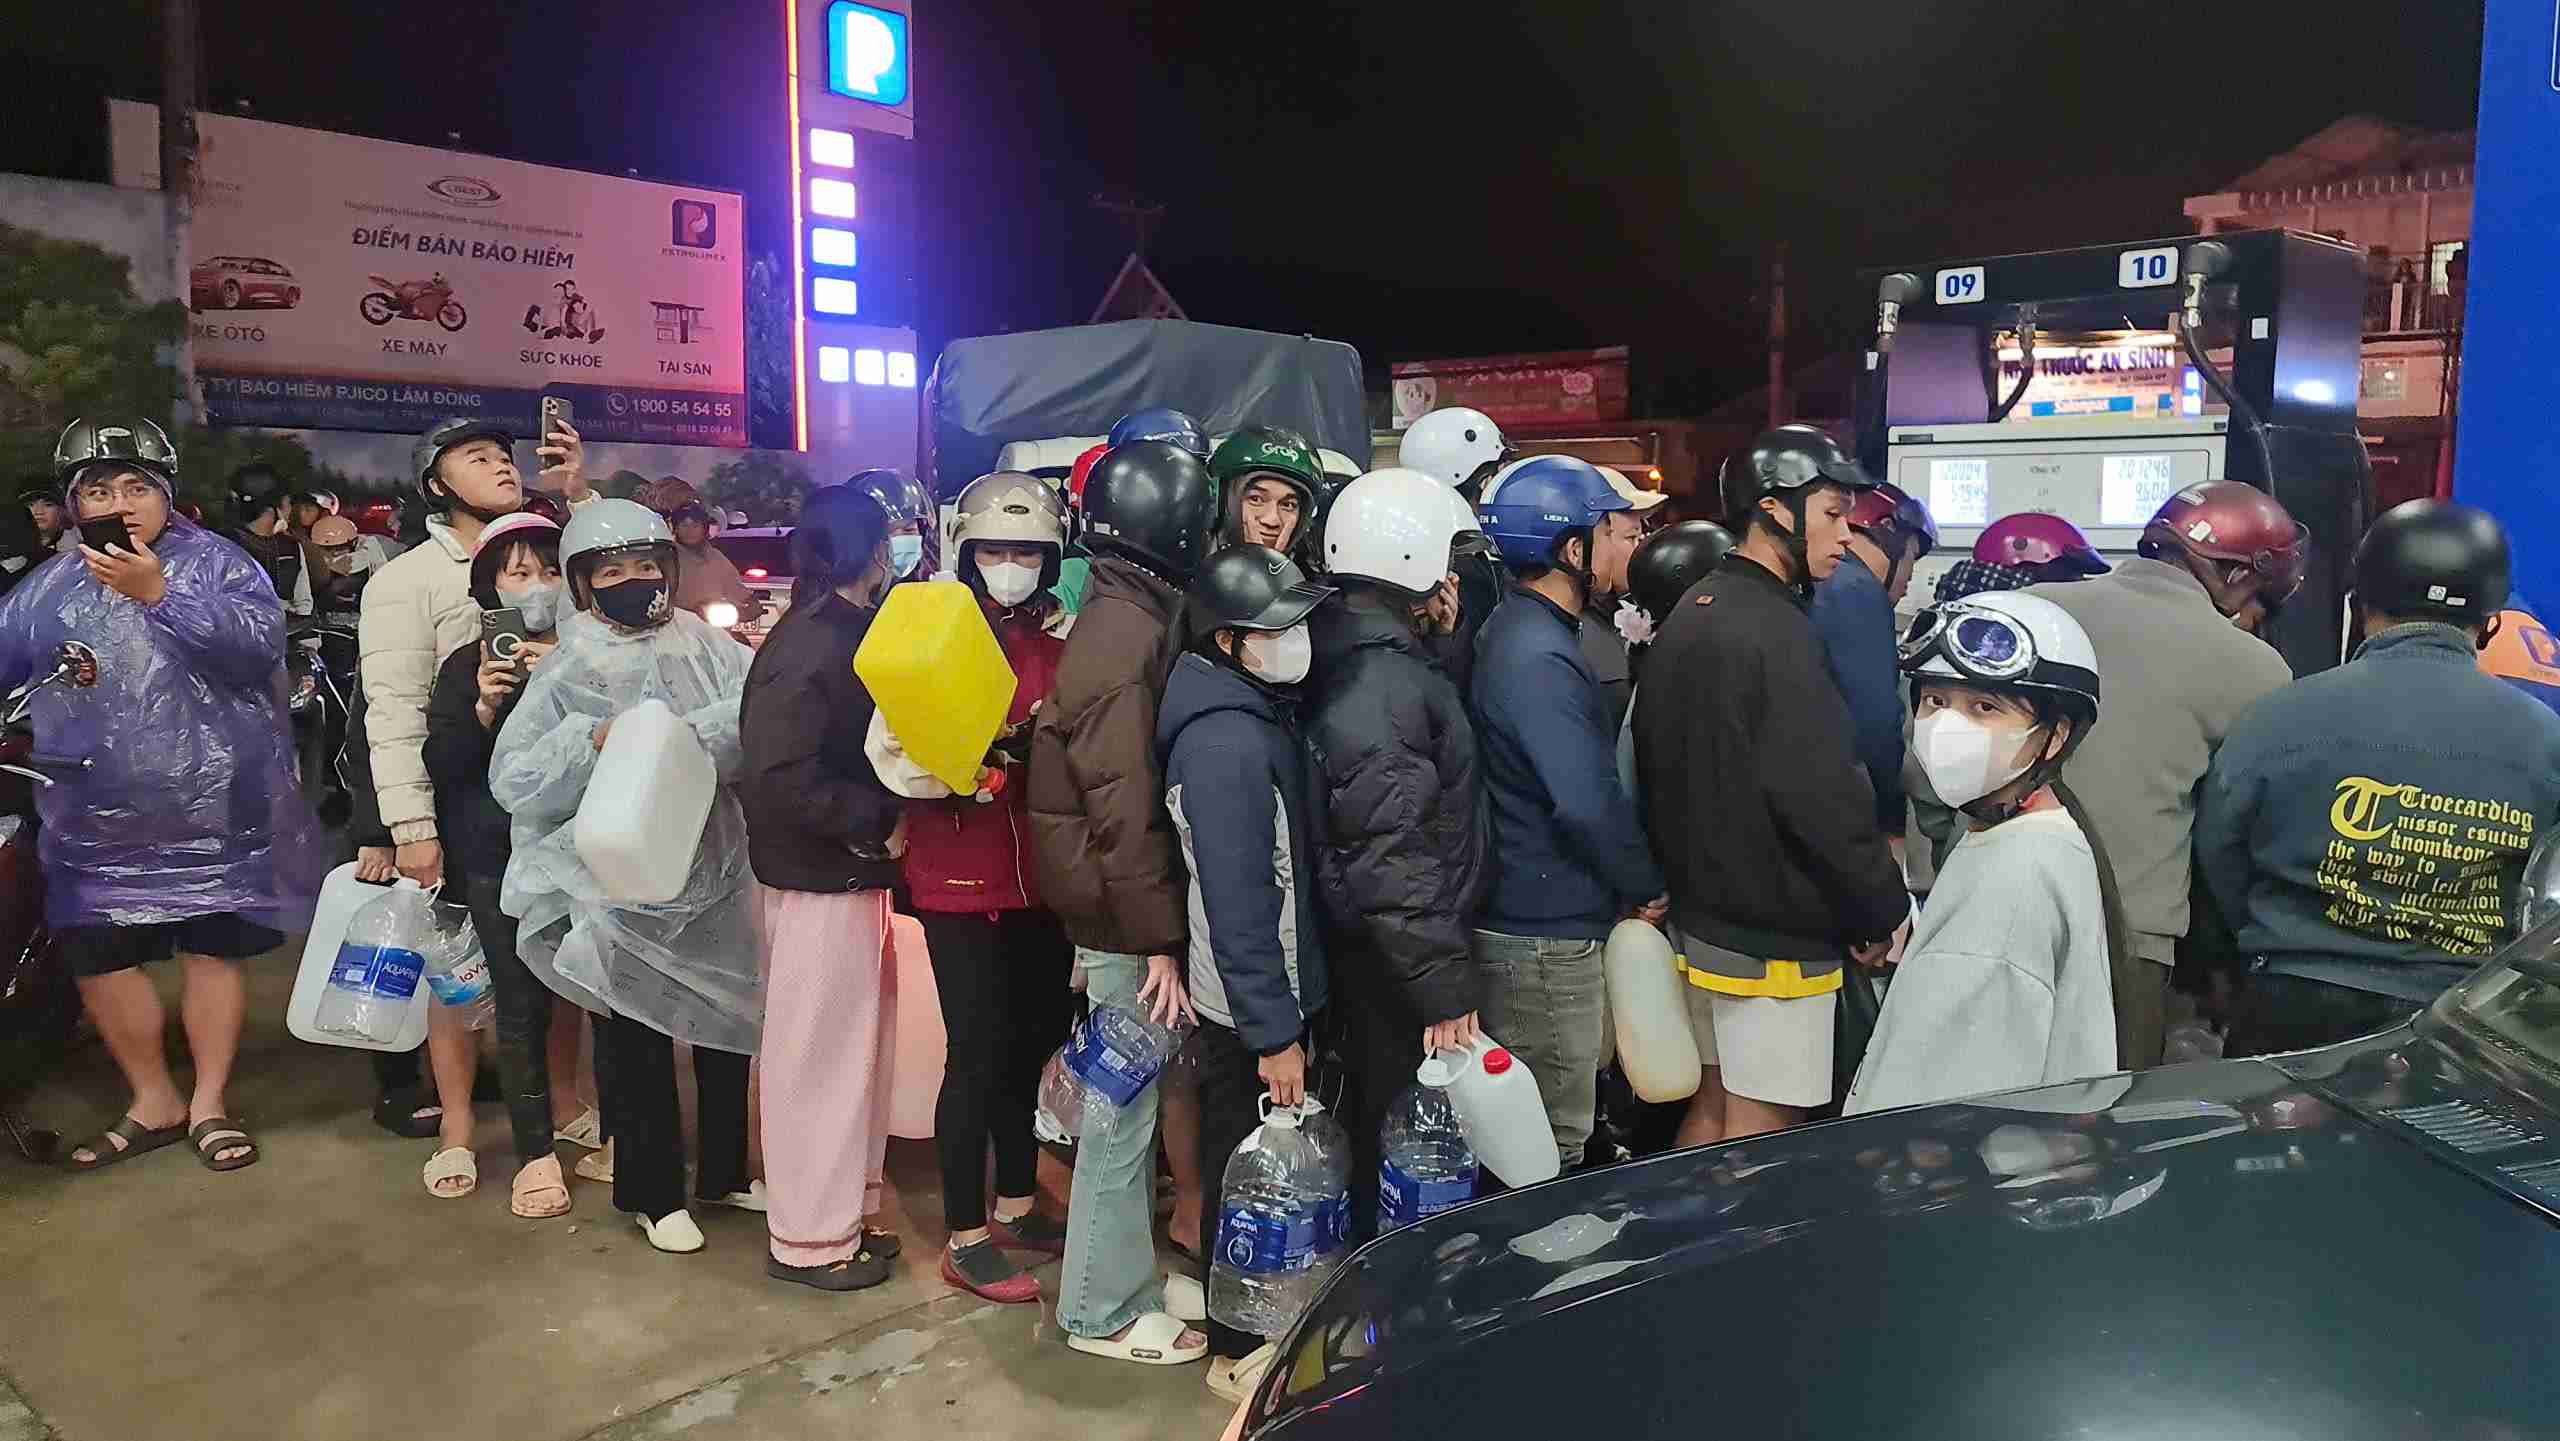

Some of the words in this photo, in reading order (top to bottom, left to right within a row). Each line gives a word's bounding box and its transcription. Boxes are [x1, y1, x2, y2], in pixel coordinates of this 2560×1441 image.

[2132, 255, 2166, 280] 10
[1945, 274, 1976, 297] 09
[382, 338, 404, 353] XE
[632, 398, 667, 414] 1900
[671, 400, 689, 416] 54
[693, 401, 710, 416] 54
[714, 403, 732, 417] 55
[2327, 839, 2356, 861] the
[2416, 855, 2435, 875] to
